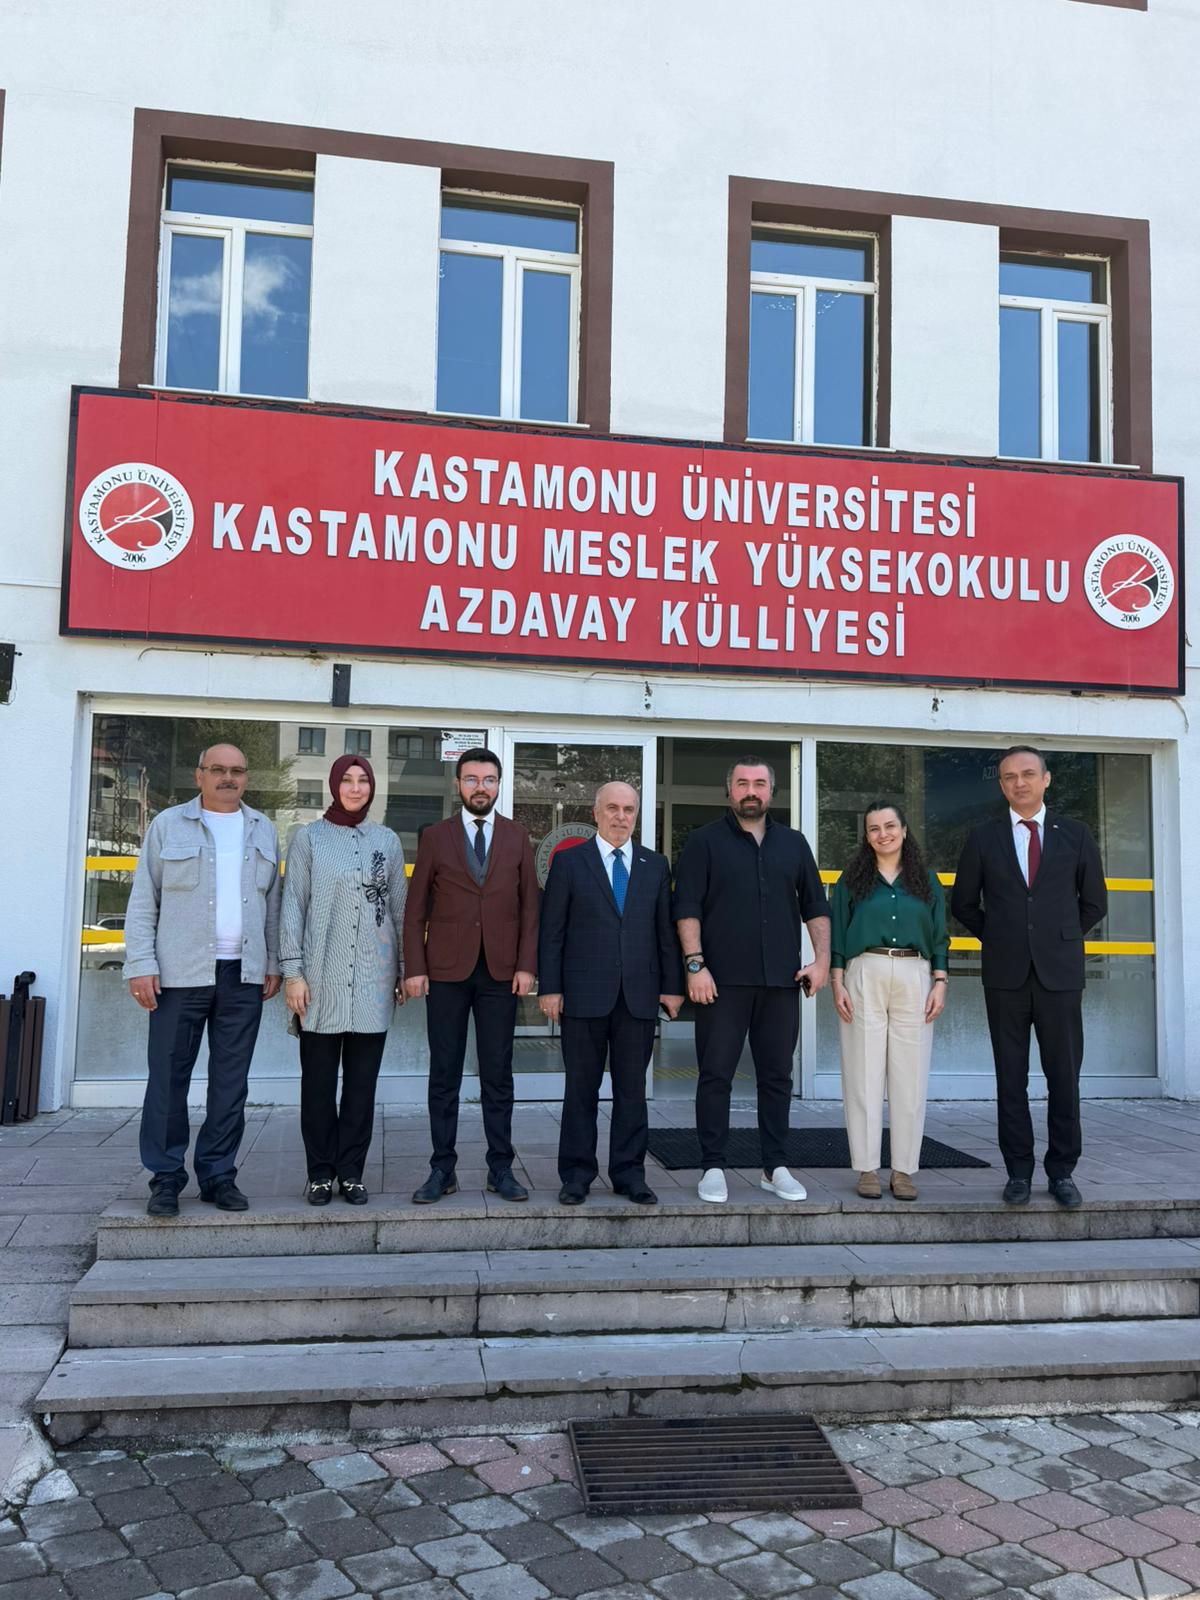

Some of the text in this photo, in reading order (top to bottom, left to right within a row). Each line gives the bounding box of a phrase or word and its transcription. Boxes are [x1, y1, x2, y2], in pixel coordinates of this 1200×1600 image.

[87, 469, 185, 553] KASTAMONU ÜNİVERSİTESİ
[374, 448, 976, 538] KASTAMONU ÜNİVERSİTESİ
[121, 552, 147, 563] 2006
[212, 501, 1070, 603] KASTAMONU MESLEK YÜKSEKOKULU
[1091, 542, 1124, 608] KASTAMONU
[419, 584, 905, 657] AZDAVAY KÜLLİYESİ
[1120, 613, 1141, 623] 2006
